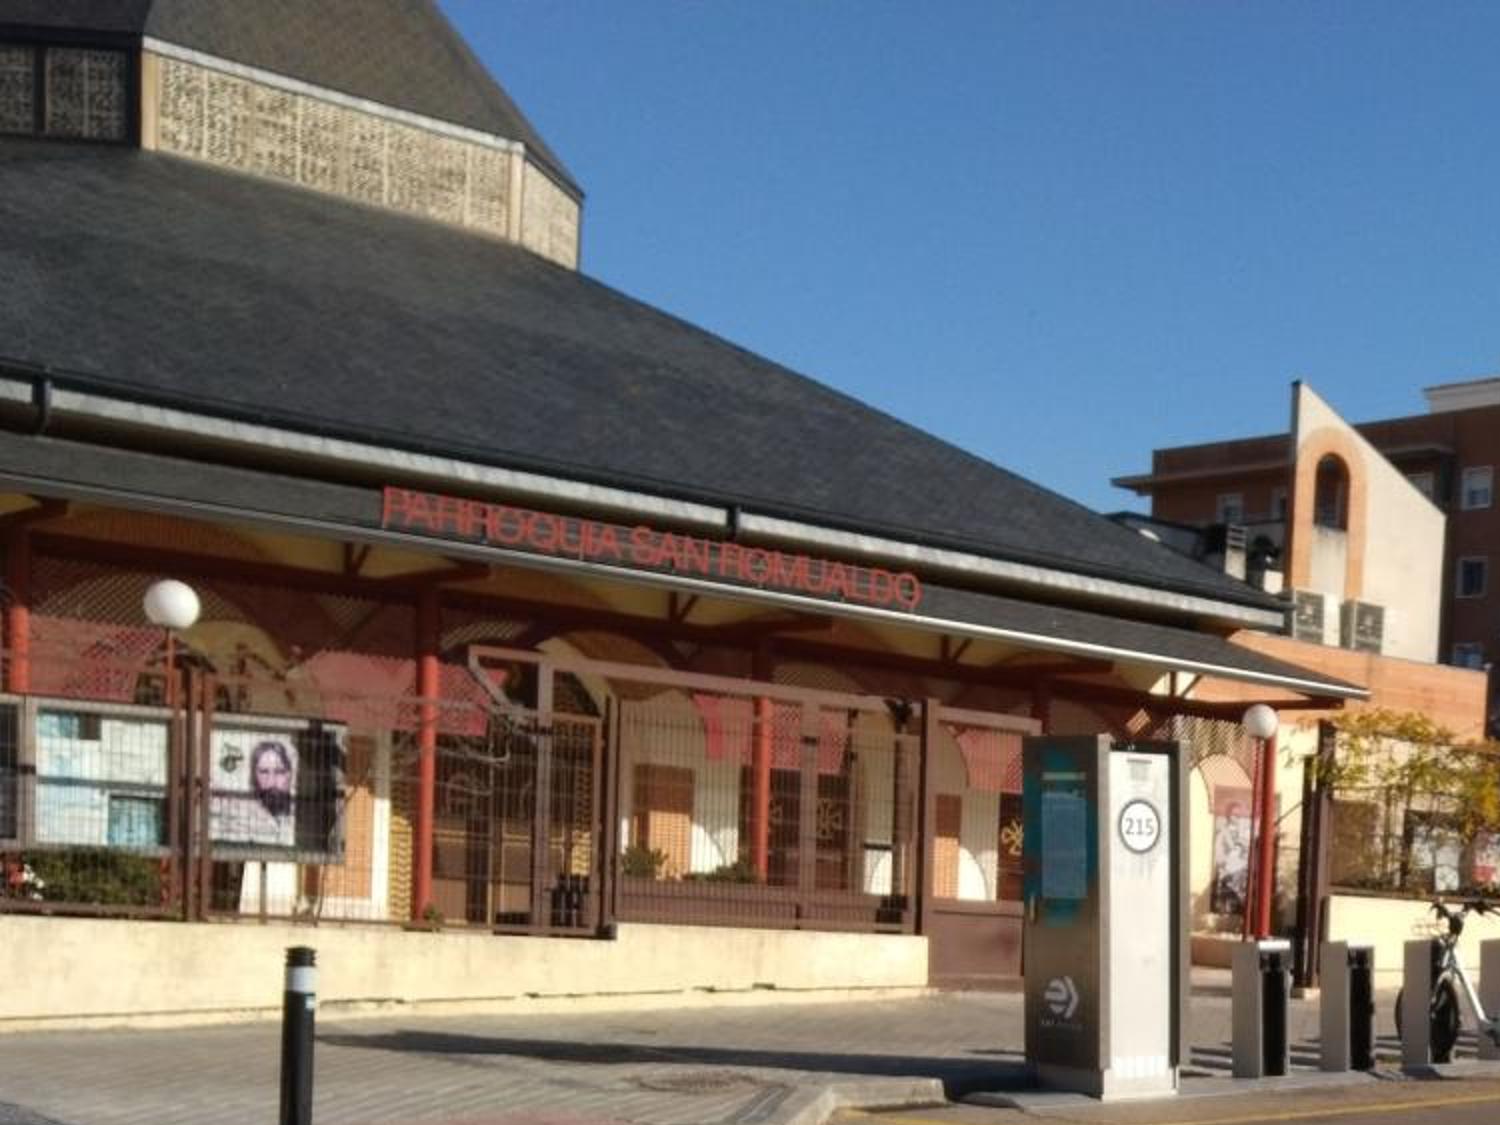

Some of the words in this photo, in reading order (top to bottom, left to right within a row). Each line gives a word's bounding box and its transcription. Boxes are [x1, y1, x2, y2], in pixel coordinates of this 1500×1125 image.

[382, 484, 621, 560] PARROQUIA
[629, 525, 709, 576] SAN
[718, 541, 923, 609] ROMUALDO
[1124, 816, 1154, 836] 215
